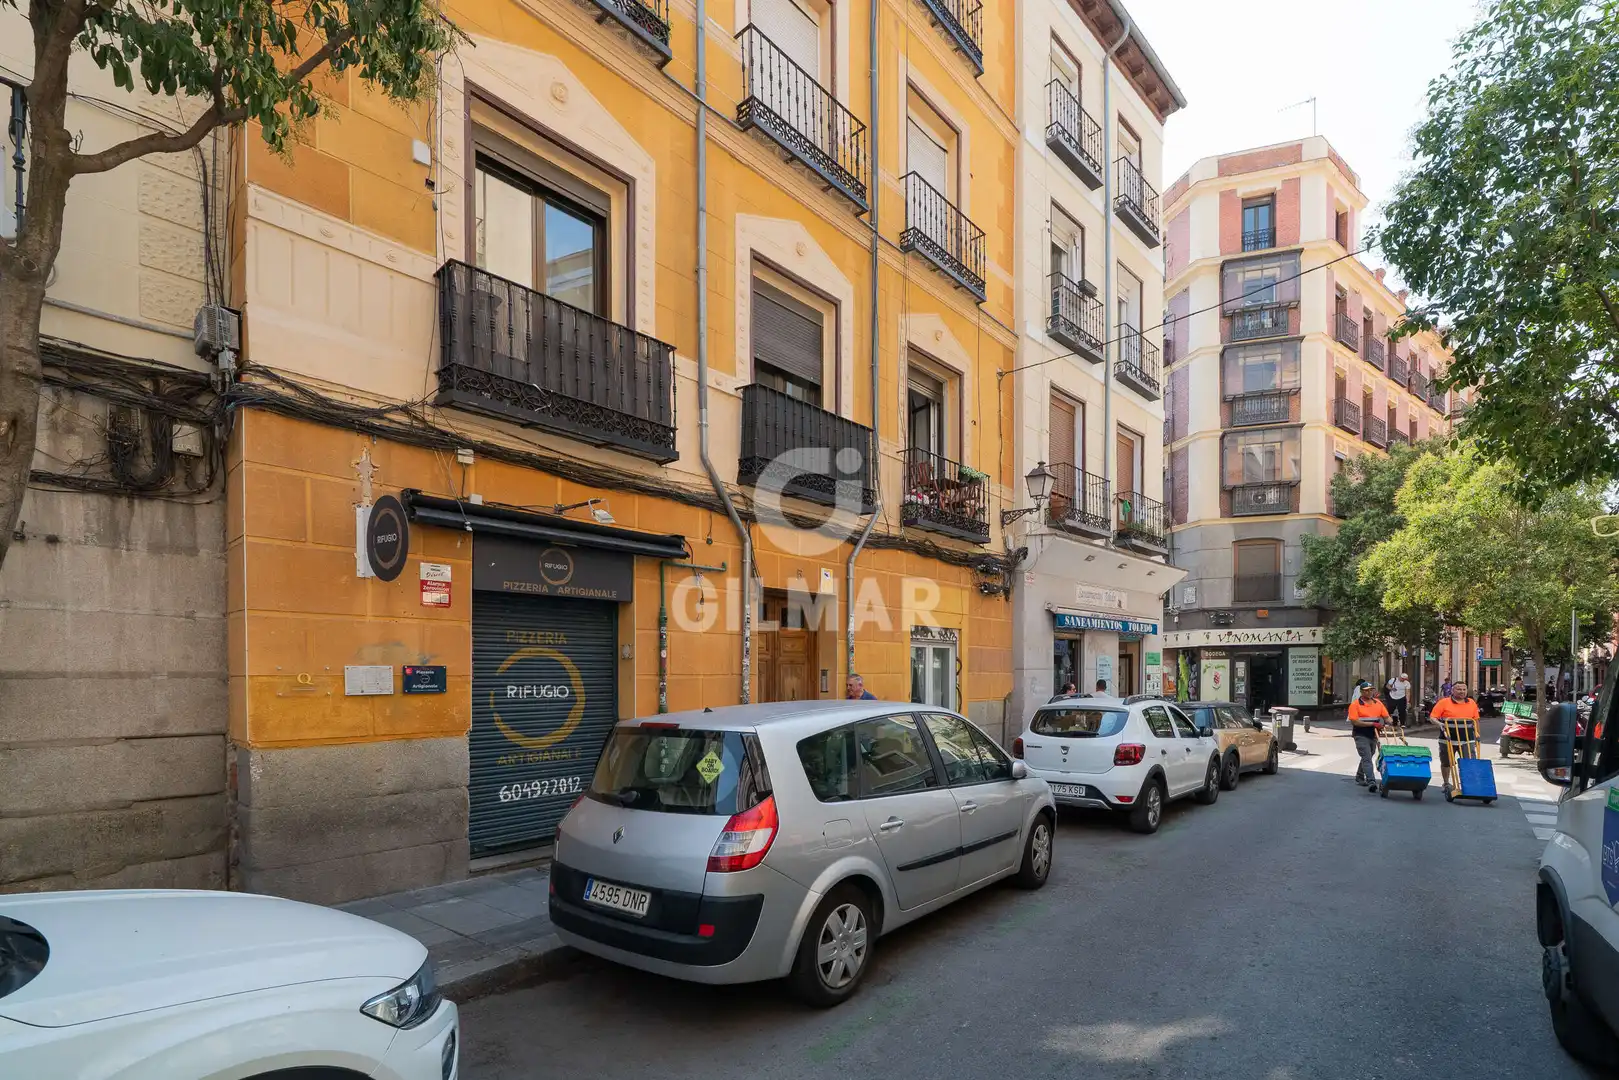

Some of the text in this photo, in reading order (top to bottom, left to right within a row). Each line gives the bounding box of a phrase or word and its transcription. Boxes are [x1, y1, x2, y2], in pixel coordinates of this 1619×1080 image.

[377, 533, 397, 544] RIFUGIO
[544, 562, 568, 571] RIFUGIO
[503, 581, 617, 599] PIZZERIA ARTIGIANALE
[1064, 615, 1123, 631] SANEAMIENTOS
[1128, 621, 1153, 633] TOLEDO
[505, 630, 568, 644] PIZZERIA
[1217, 629, 1304, 643] VINOMANIA
[506, 684, 570, 699] RIFUGIO
[499, 776, 583, 803] 604922012
[1068, 785, 1084, 795] KSD
[592, 883, 648, 912] 4595 DNR
